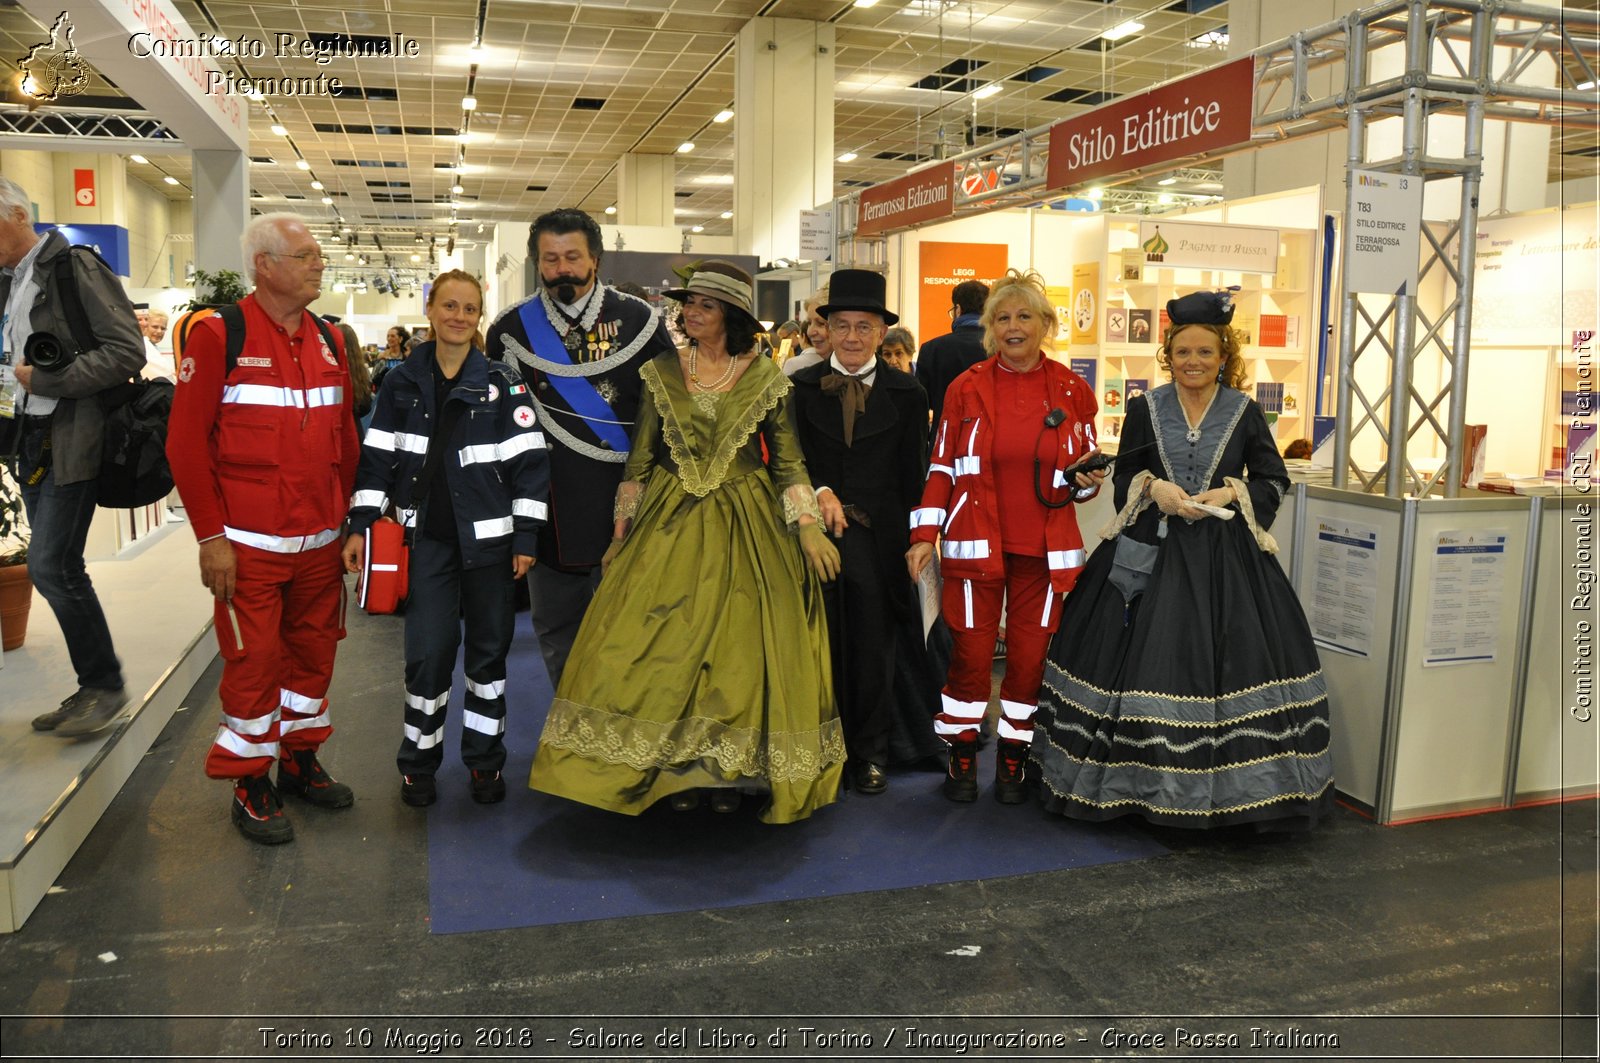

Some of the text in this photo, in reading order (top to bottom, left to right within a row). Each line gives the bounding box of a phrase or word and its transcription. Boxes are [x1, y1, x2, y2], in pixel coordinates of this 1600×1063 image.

[1068, 97, 1221, 171] Stilo Editrice
[863, 176, 947, 222] Terrarossa Edizioni
[1357, 201, 1372, 213] T83
[1356, 218, 1407, 231] STILO EDITRICE
[1356, 235, 1401, 246] TERRAROSSA
[1355, 243, 1384, 253] EDIZIONI
[952, 268, 976, 277] LEGGI
[239, 358, 271, 366] ALBERTO
